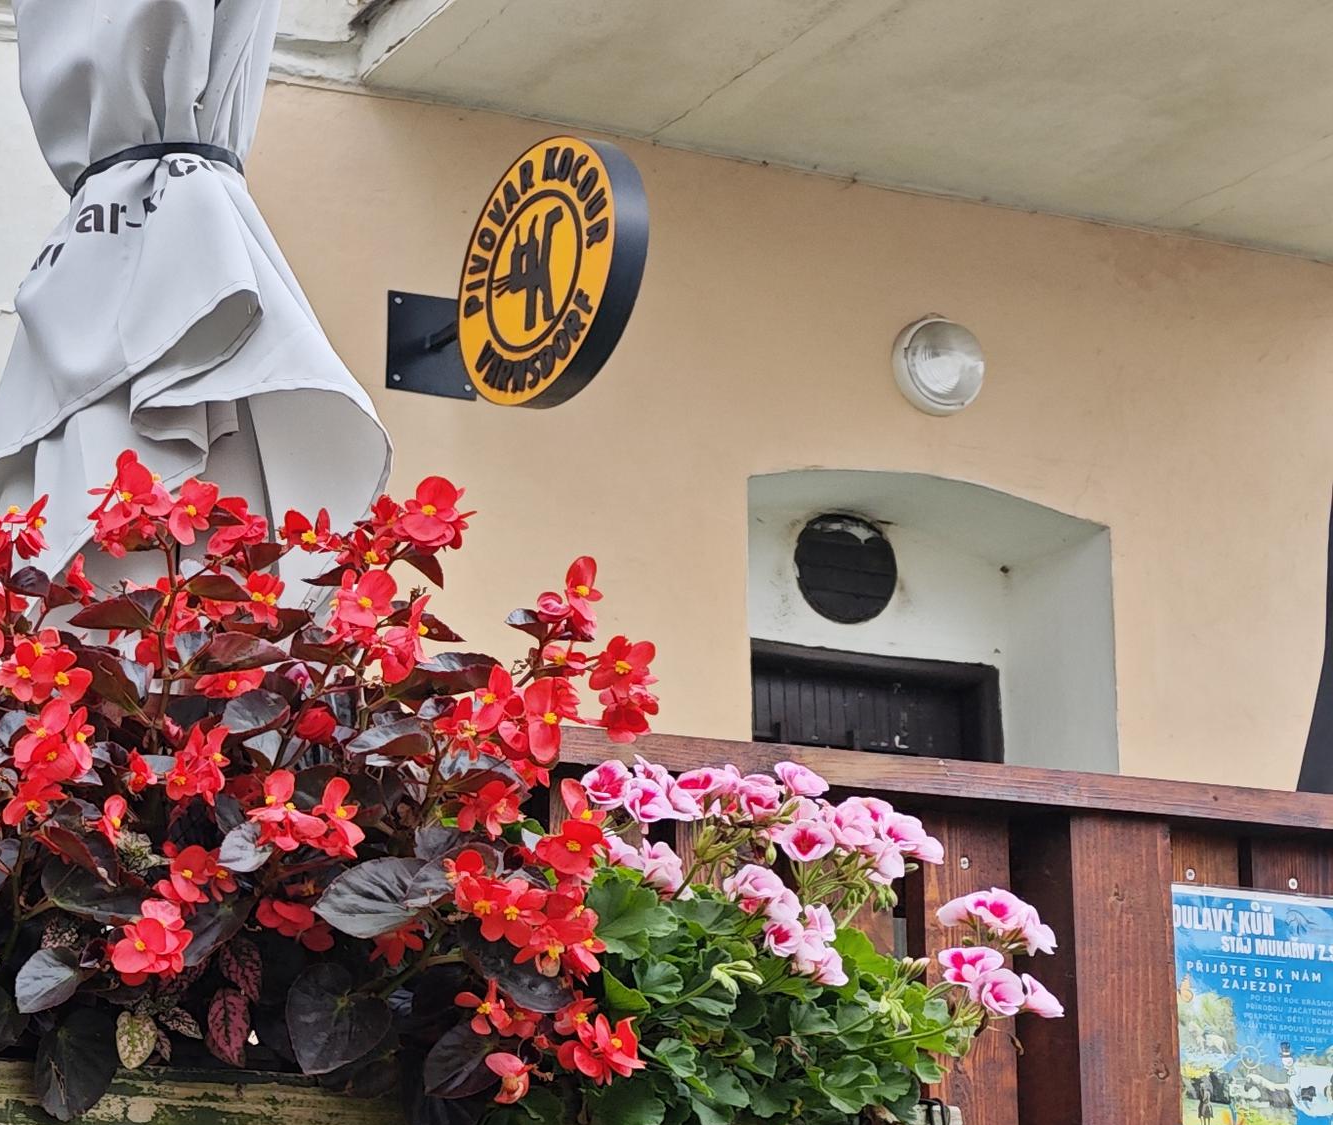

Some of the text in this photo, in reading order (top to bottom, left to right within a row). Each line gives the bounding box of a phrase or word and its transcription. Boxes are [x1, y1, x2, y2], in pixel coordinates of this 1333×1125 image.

[463, 146, 609, 319] PIVOVAR KOCOUR
[475, 288, 593, 393] VARNSDORF
[1239, 901, 1275, 937] KŮŇ
[1221, 933, 1251, 955] STÁJ
[1255, 936, 1315, 961] MUKAŘOV
[1186, 960, 1322, 983] PŘIJĎTE SI K NÁM
[1222, 978, 1293, 994] ZAJEZDIT
